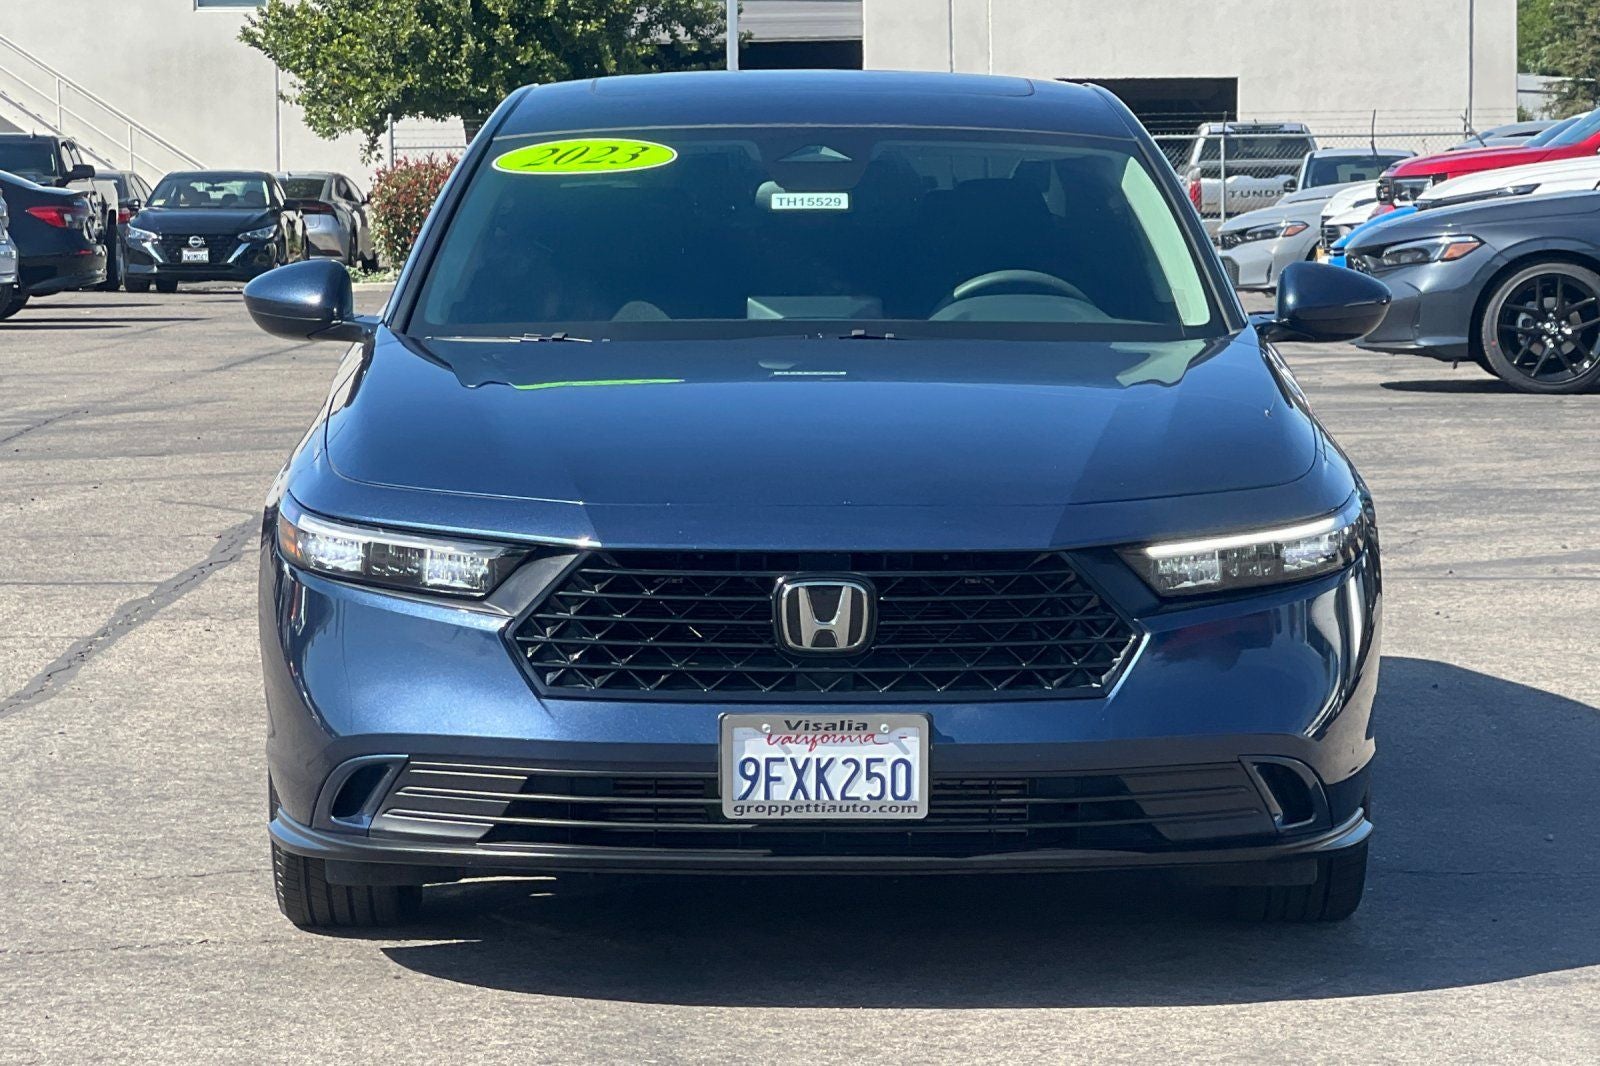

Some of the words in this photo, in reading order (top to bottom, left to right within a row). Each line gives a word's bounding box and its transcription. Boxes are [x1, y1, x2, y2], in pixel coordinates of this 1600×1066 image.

[520, 146, 650, 168] 2023
[776, 197, 842, 207] TH15529
[784, 719, 868, 732] Visalia
[738, 756, 912, 801] 9FXK250
[733, 802, 918, 816] groppettiauto.com
